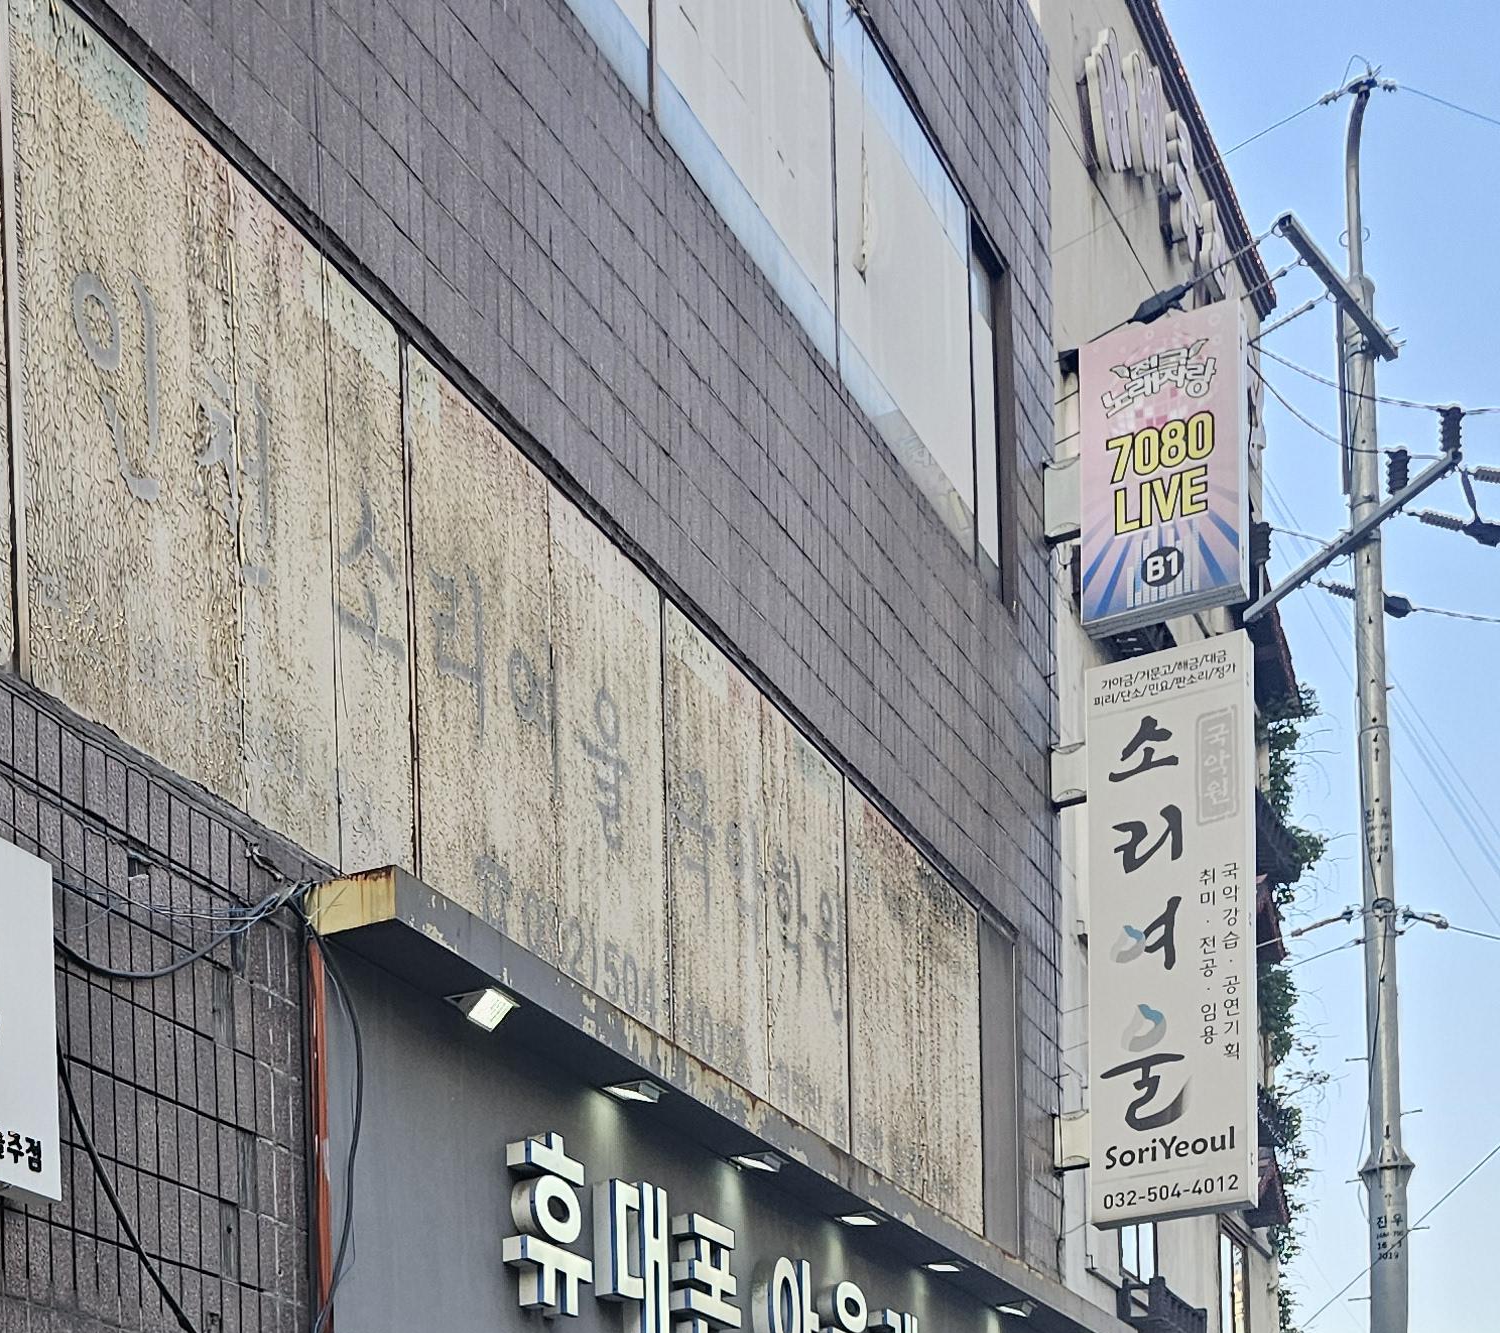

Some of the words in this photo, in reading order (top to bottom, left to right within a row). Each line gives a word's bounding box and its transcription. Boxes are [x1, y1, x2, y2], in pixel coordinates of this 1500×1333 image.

[1101, 356, 1217, 418] 노래자랑
[1106, 410, 1215, 484] 7080
[1114, 463, 1209, 536] LIVE
[1145, 551, 1180, 581] B1
[1100, 715, 1192, 1131] 소리여울
[1104, 1126, 1237, 1171] SoriYeoul
[1103, 1173, 1240, 1211] 032-504-4012
